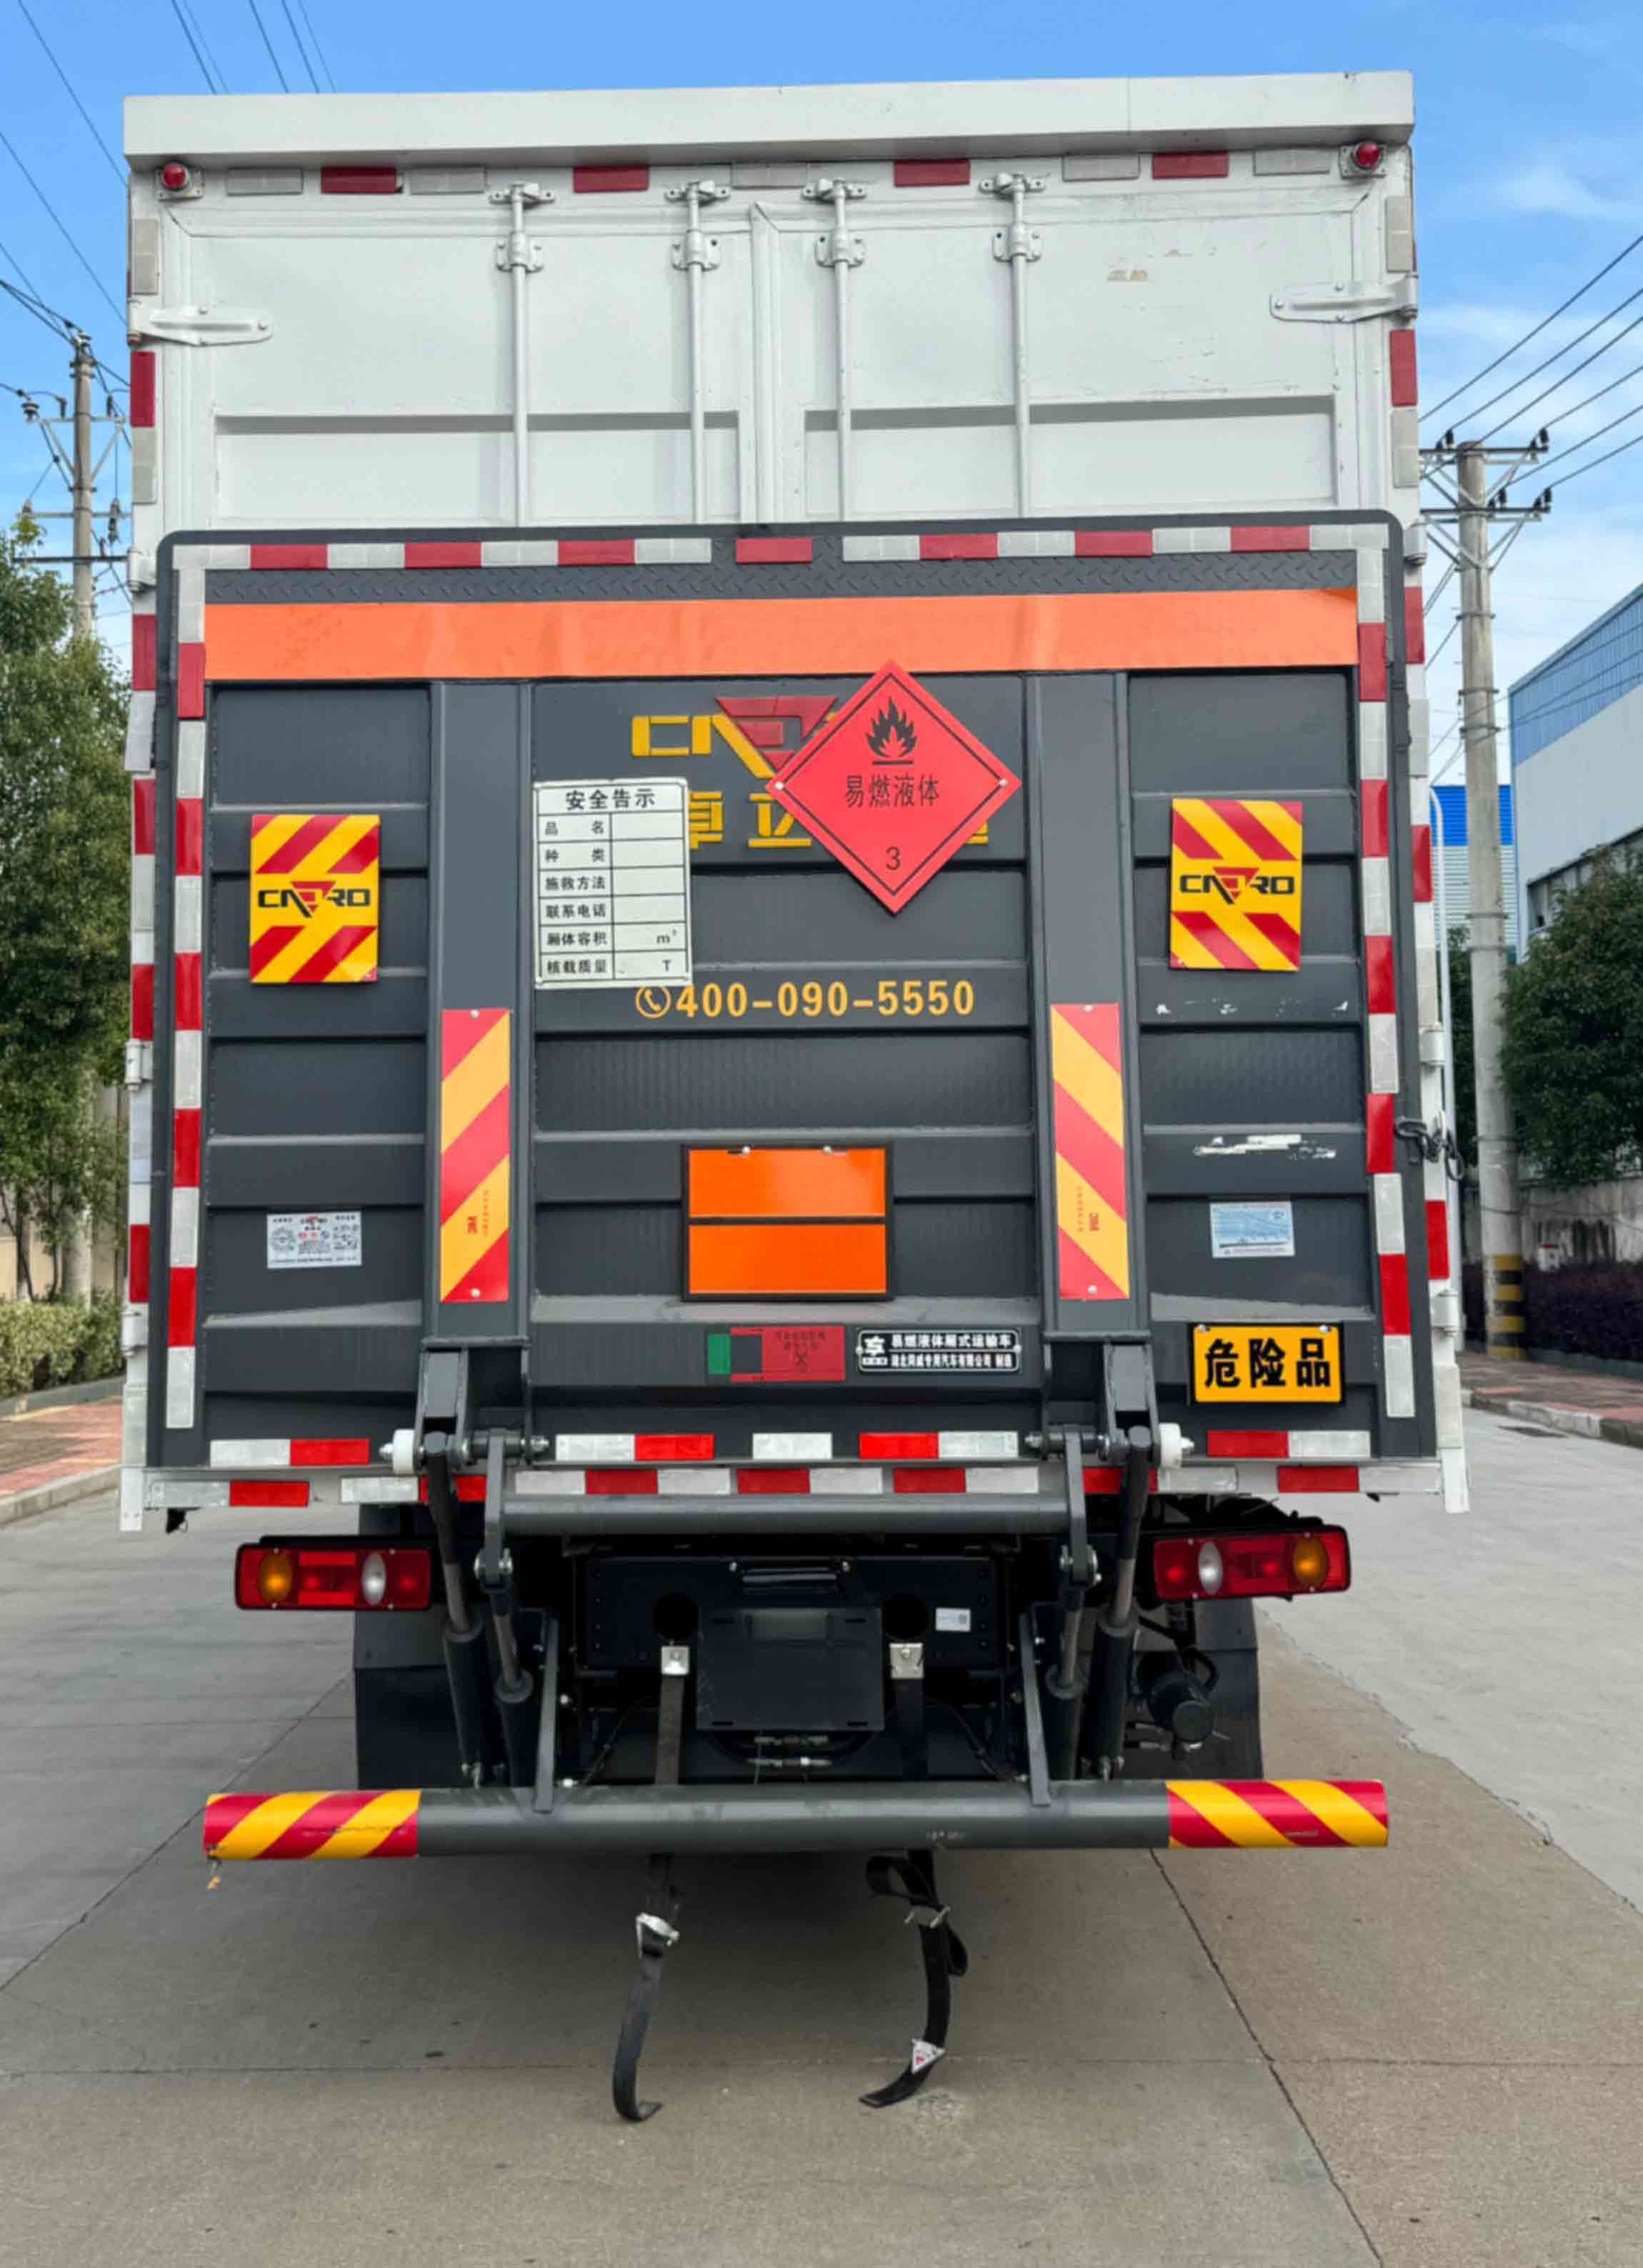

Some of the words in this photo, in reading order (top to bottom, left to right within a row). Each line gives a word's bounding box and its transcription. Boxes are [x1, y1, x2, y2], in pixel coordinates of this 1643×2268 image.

[566, 789, 655, 810] 安全告示
[846, 772, 939, 807] 易燃液体
[886, 846, 901, 871] 3
[545, 904, 606, 919] 联系电话
[662, 960, 671, 972] T
[676, 980, 974, 1018] 400-090-5550
[1204, 1338, 1330, 1388] 危险品
